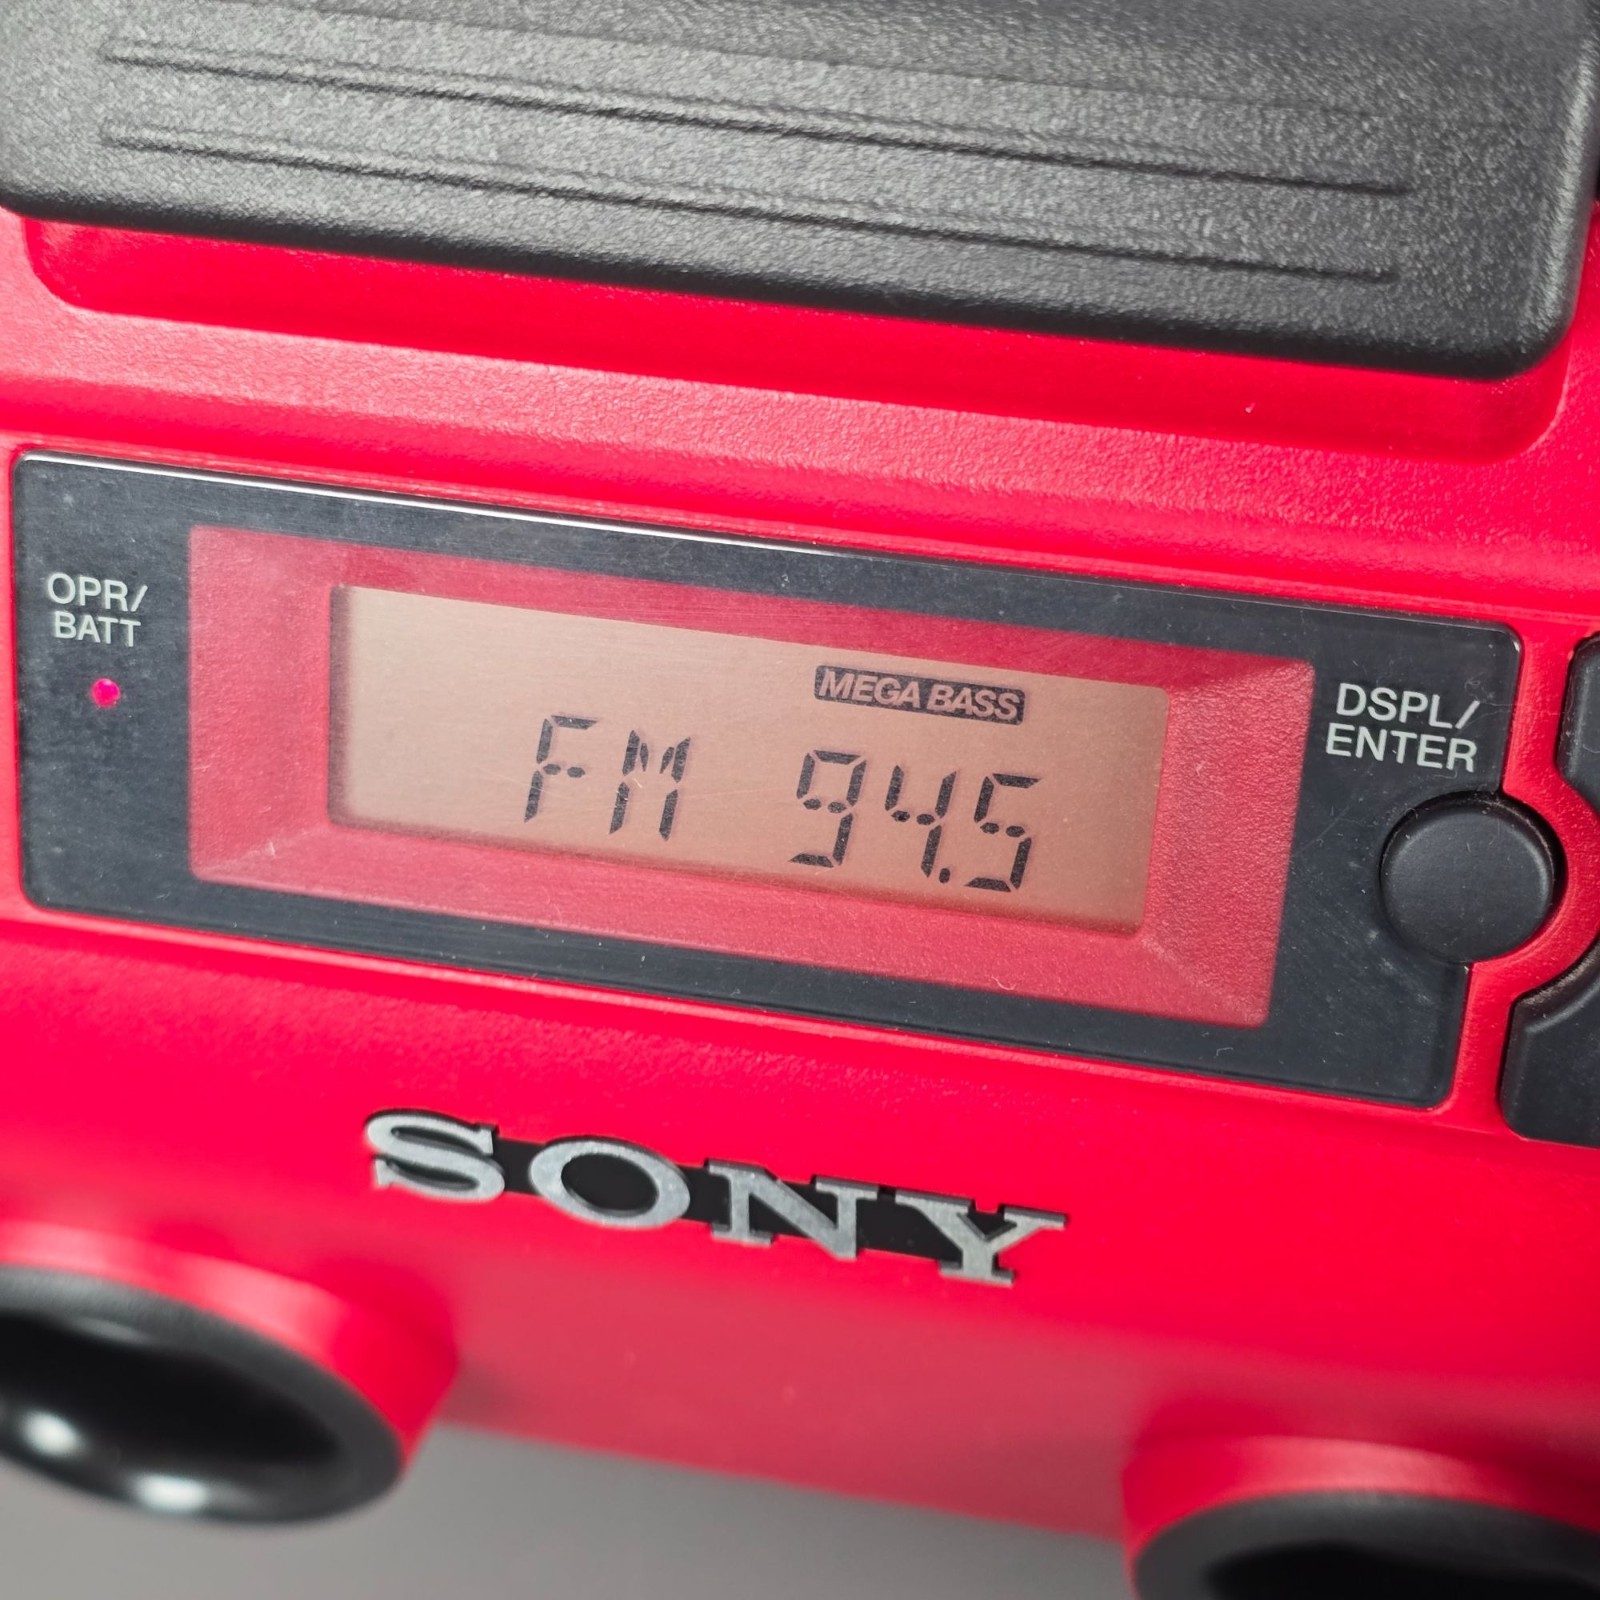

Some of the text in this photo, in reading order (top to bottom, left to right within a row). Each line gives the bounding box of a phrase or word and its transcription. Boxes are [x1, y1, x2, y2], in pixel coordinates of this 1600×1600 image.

[47, 572, 148, 612] OPR/
[54, 610, 141, 647] BATT
[818, 668, 1021, 722] MEGA BASS
[1336, 682, 1481, 730] DSPL/
[1325, 722, 1477, 773] ENTER
[524, 715, 1042, 892] FM 94.5
[365, 1108, 1068, 1286] SONY
